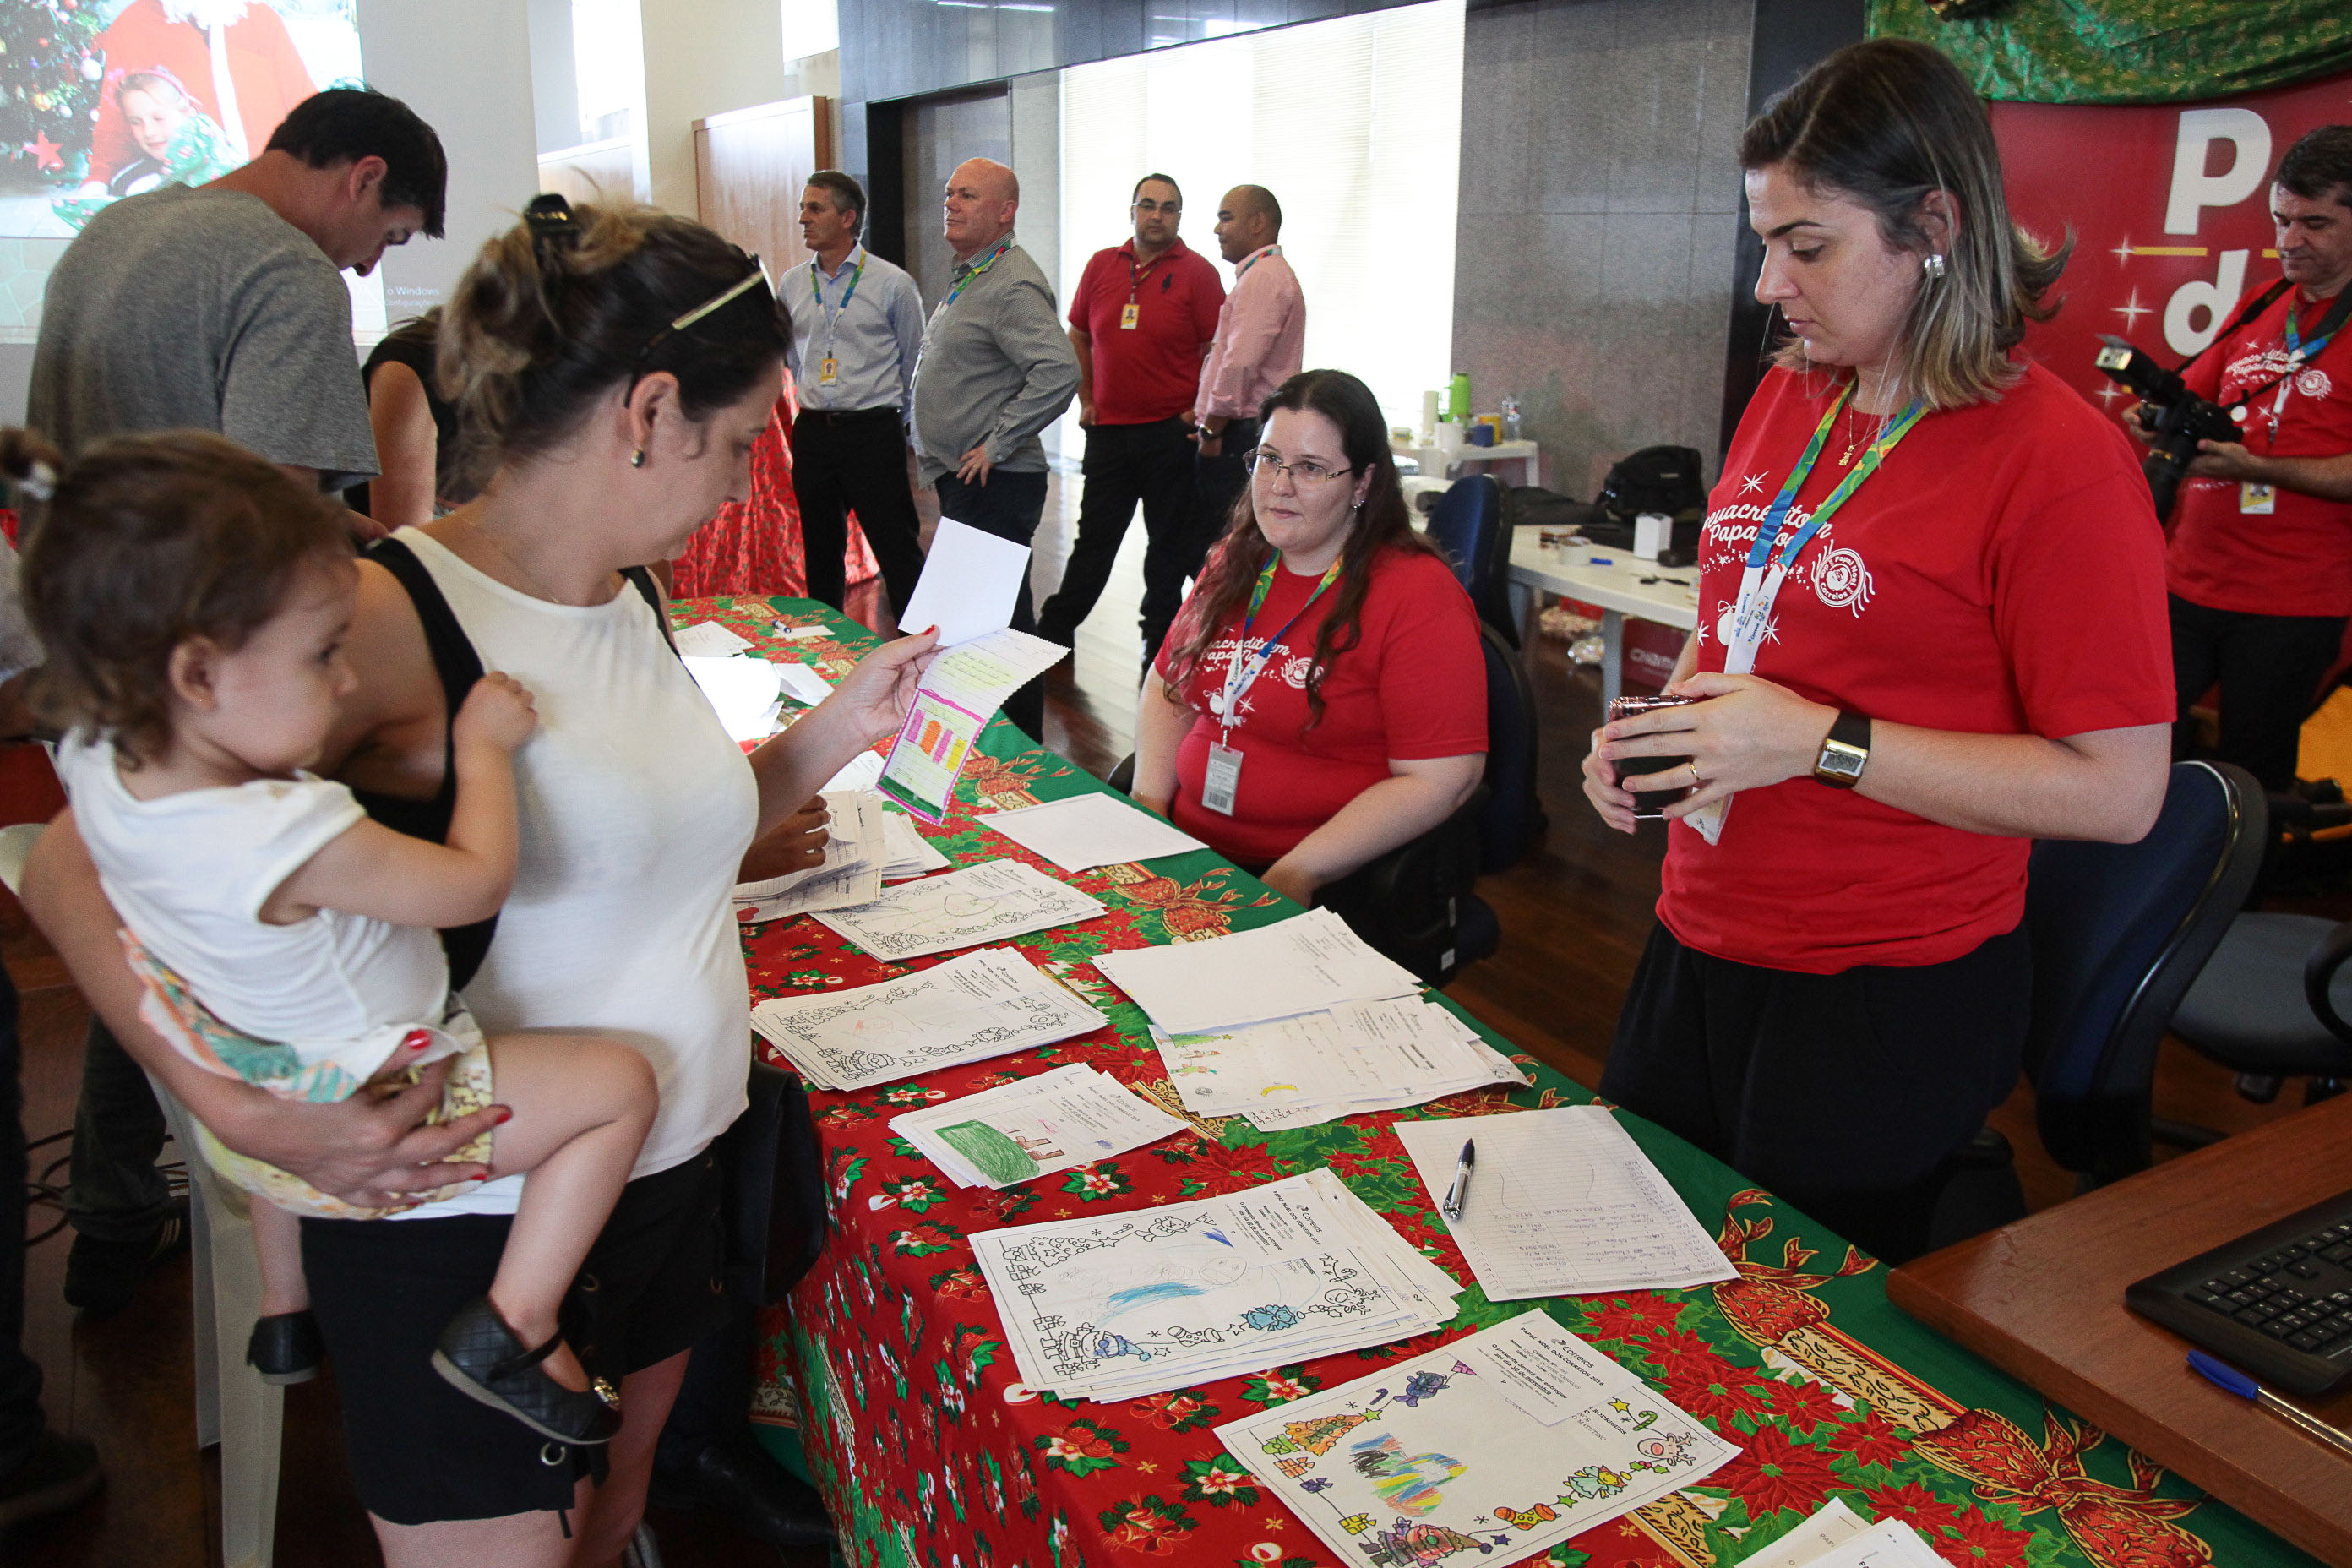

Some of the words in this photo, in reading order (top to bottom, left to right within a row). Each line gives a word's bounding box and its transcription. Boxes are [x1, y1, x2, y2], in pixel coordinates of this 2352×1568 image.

[395, 287, 440, 296] Windows
[1709, 524, 1760, 549] Papa
[1835, 556, 1854, 566] Papai
[1820, 583, 1848, 600] Correios
[1303, 1211, 1323, 1233] Correios
[1521, 1326, 1538, 1340] PAPAI
[1538, 1340, 1551, 1351] NOEL
[1551, 1349, 1563, 1358] DOS
[1563, 1357, 1591, 1377] CORREIOS
[1590, 1376, 1605, 1386] 2016
[1563, 1346, 1595, 1369] Correios
[1495, 1348, 1518, 1364] presente
[1517, 1363, 1536, 1376] deverá
[1544, 1380, 1568, 1399] entregue
[1503, 1358, 1512, 1367] dia
[1524, 1375, 1552, 1396] novembro
[1578, 1419, 1607, 1441] MATUTINO
[1592, 1408, 1627, 1435] RODRIGUES
